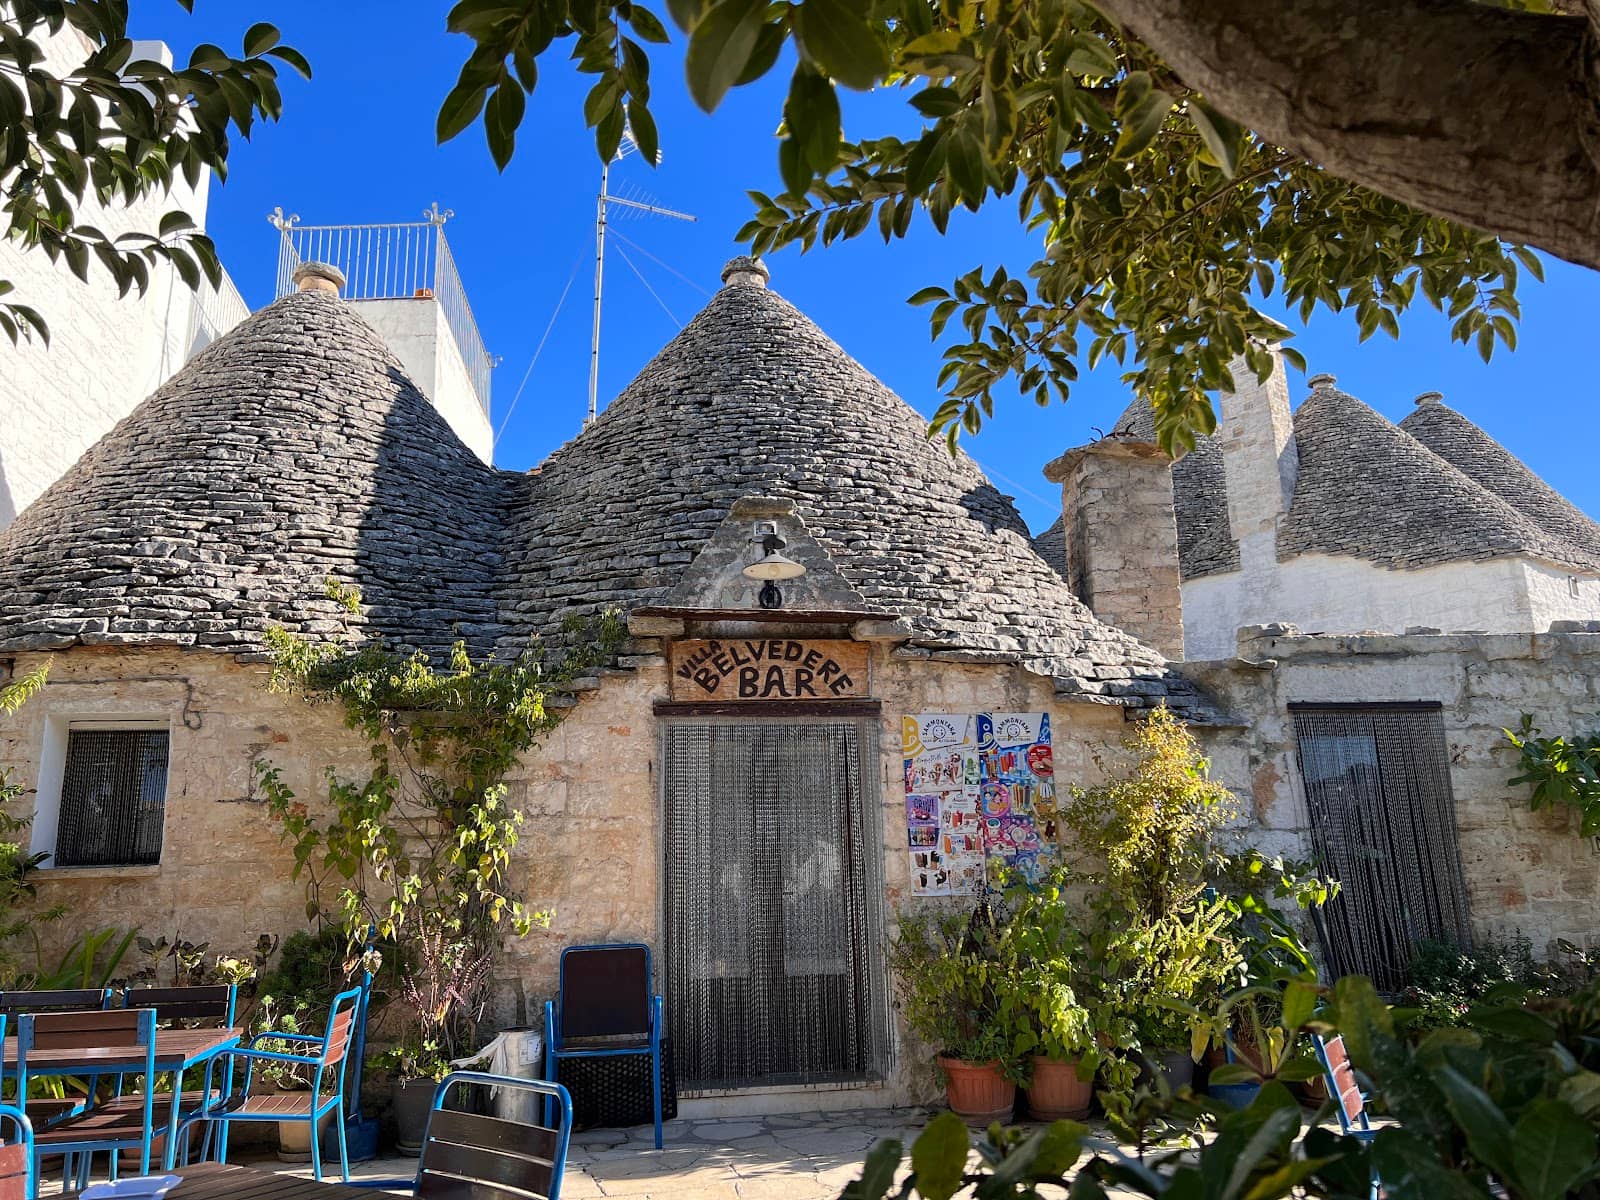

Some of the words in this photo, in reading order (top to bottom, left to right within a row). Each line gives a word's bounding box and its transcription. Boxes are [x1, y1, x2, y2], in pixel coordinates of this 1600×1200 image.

[676, 640, 722, 680] VILLA
[693, 640, 853, 697] BELVEDERE
[739, 665, 818, 698] BAR
[922, 719, 956, 736] SAMMONTANA
[996, 717, 1031, 735] SAMMONTANA
